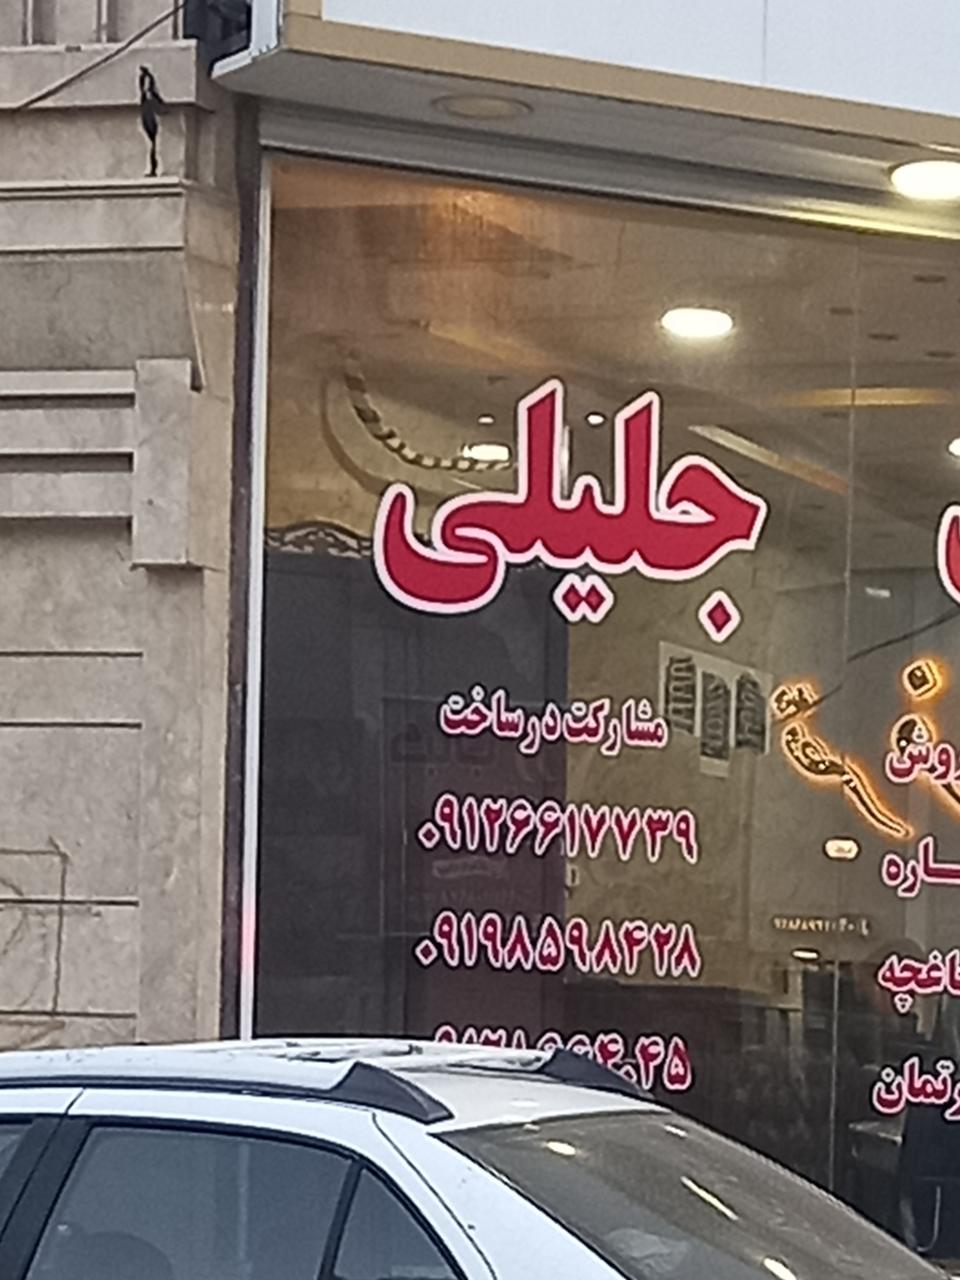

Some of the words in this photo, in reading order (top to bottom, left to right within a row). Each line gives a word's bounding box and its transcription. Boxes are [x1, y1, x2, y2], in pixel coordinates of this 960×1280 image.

[373, 377, 768, 642] جلیلی
[440, 685, 525, 743] ساخت
[519, 703, 561, 754] در
[562, 698, 668, 756] مشارکت
[417, 793, 698, 864] ۰۹۱۲۶۶۱۷۷۳۹
